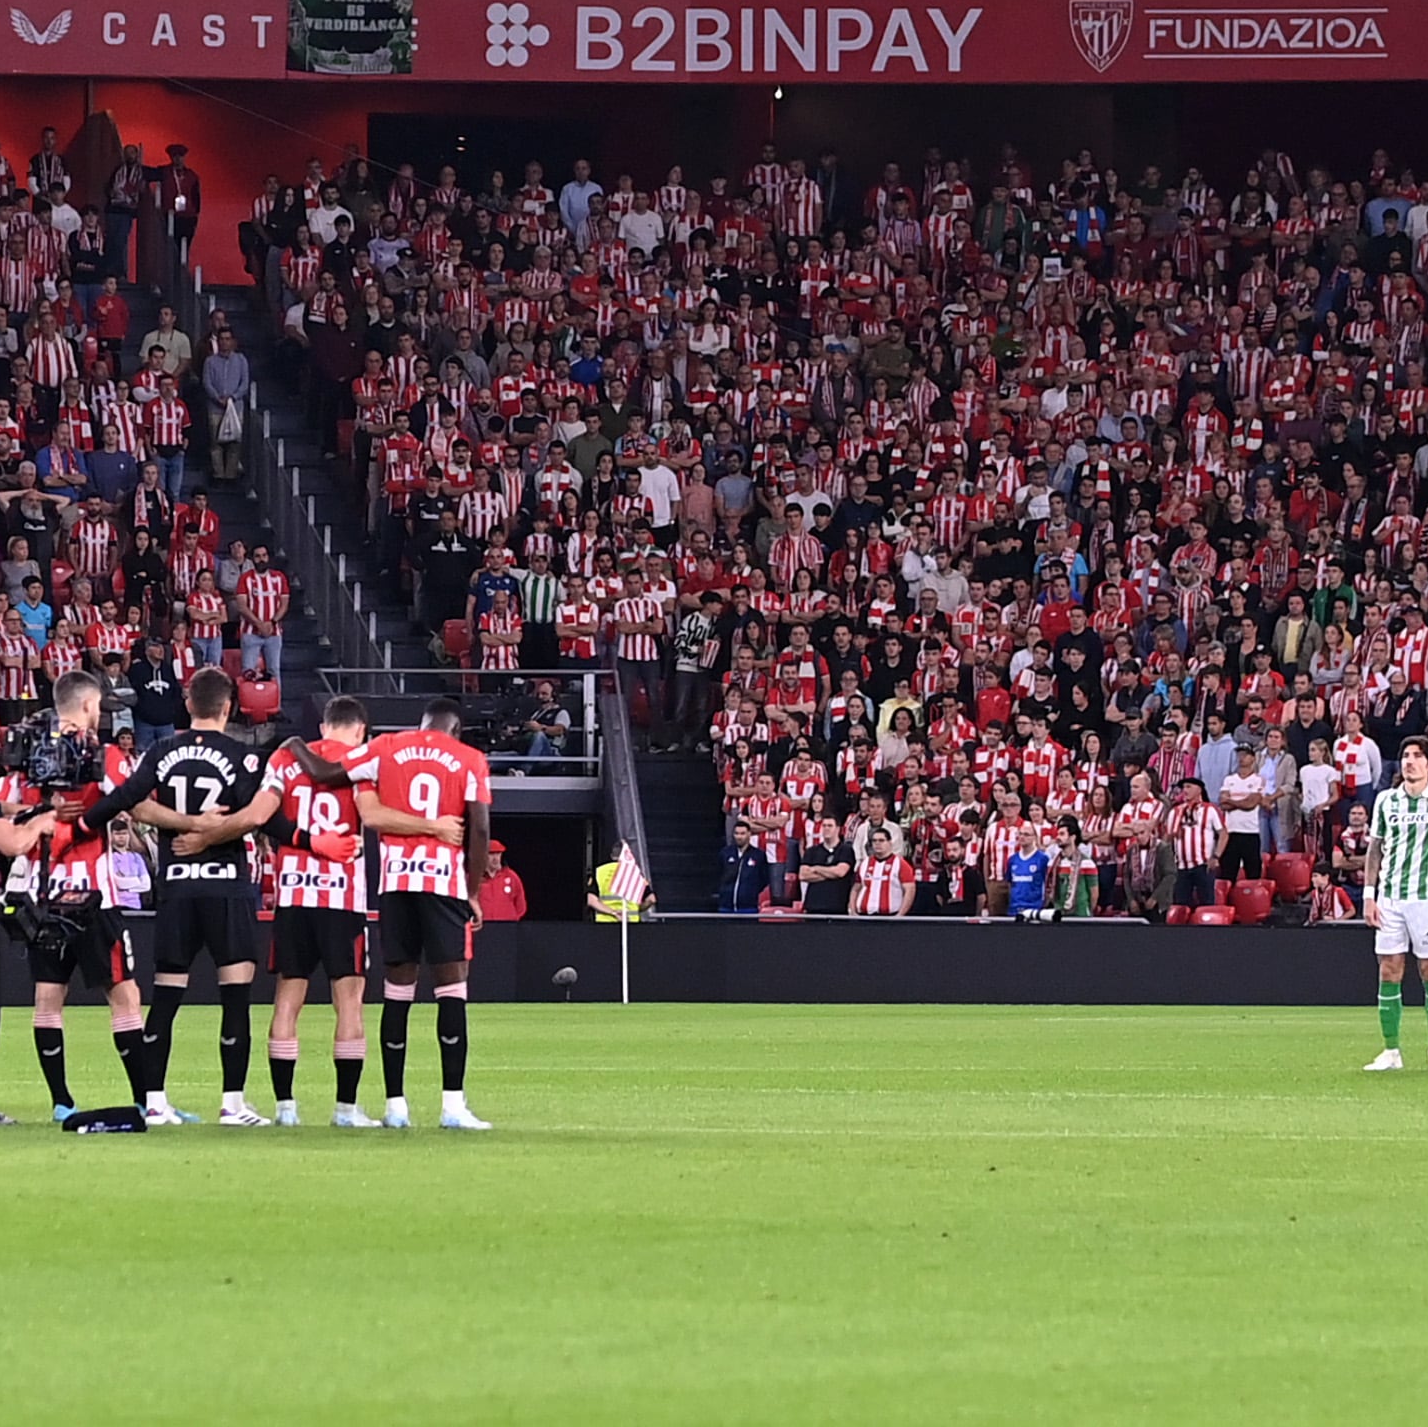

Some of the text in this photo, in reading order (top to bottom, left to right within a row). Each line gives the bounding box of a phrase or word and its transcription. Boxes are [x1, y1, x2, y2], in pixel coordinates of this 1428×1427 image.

[346, 4, 365, 17] ES
[305, 18, 406, 32] VERDIBLANCA
[1149, 18, 1385, 49] FUNDAZIOA
[575, 6, 983, 72] B2BINPAY
[156, 745, 237, 786] AGIRREZABALA
[393, 744, 462, 773] WILLIAMS
[408, 772, 441, 820] 9
[166, 863, 237, 881] DIGI
[387, 860, 450, 877] DIGI
[281, 873, 345, 889] DIGI
